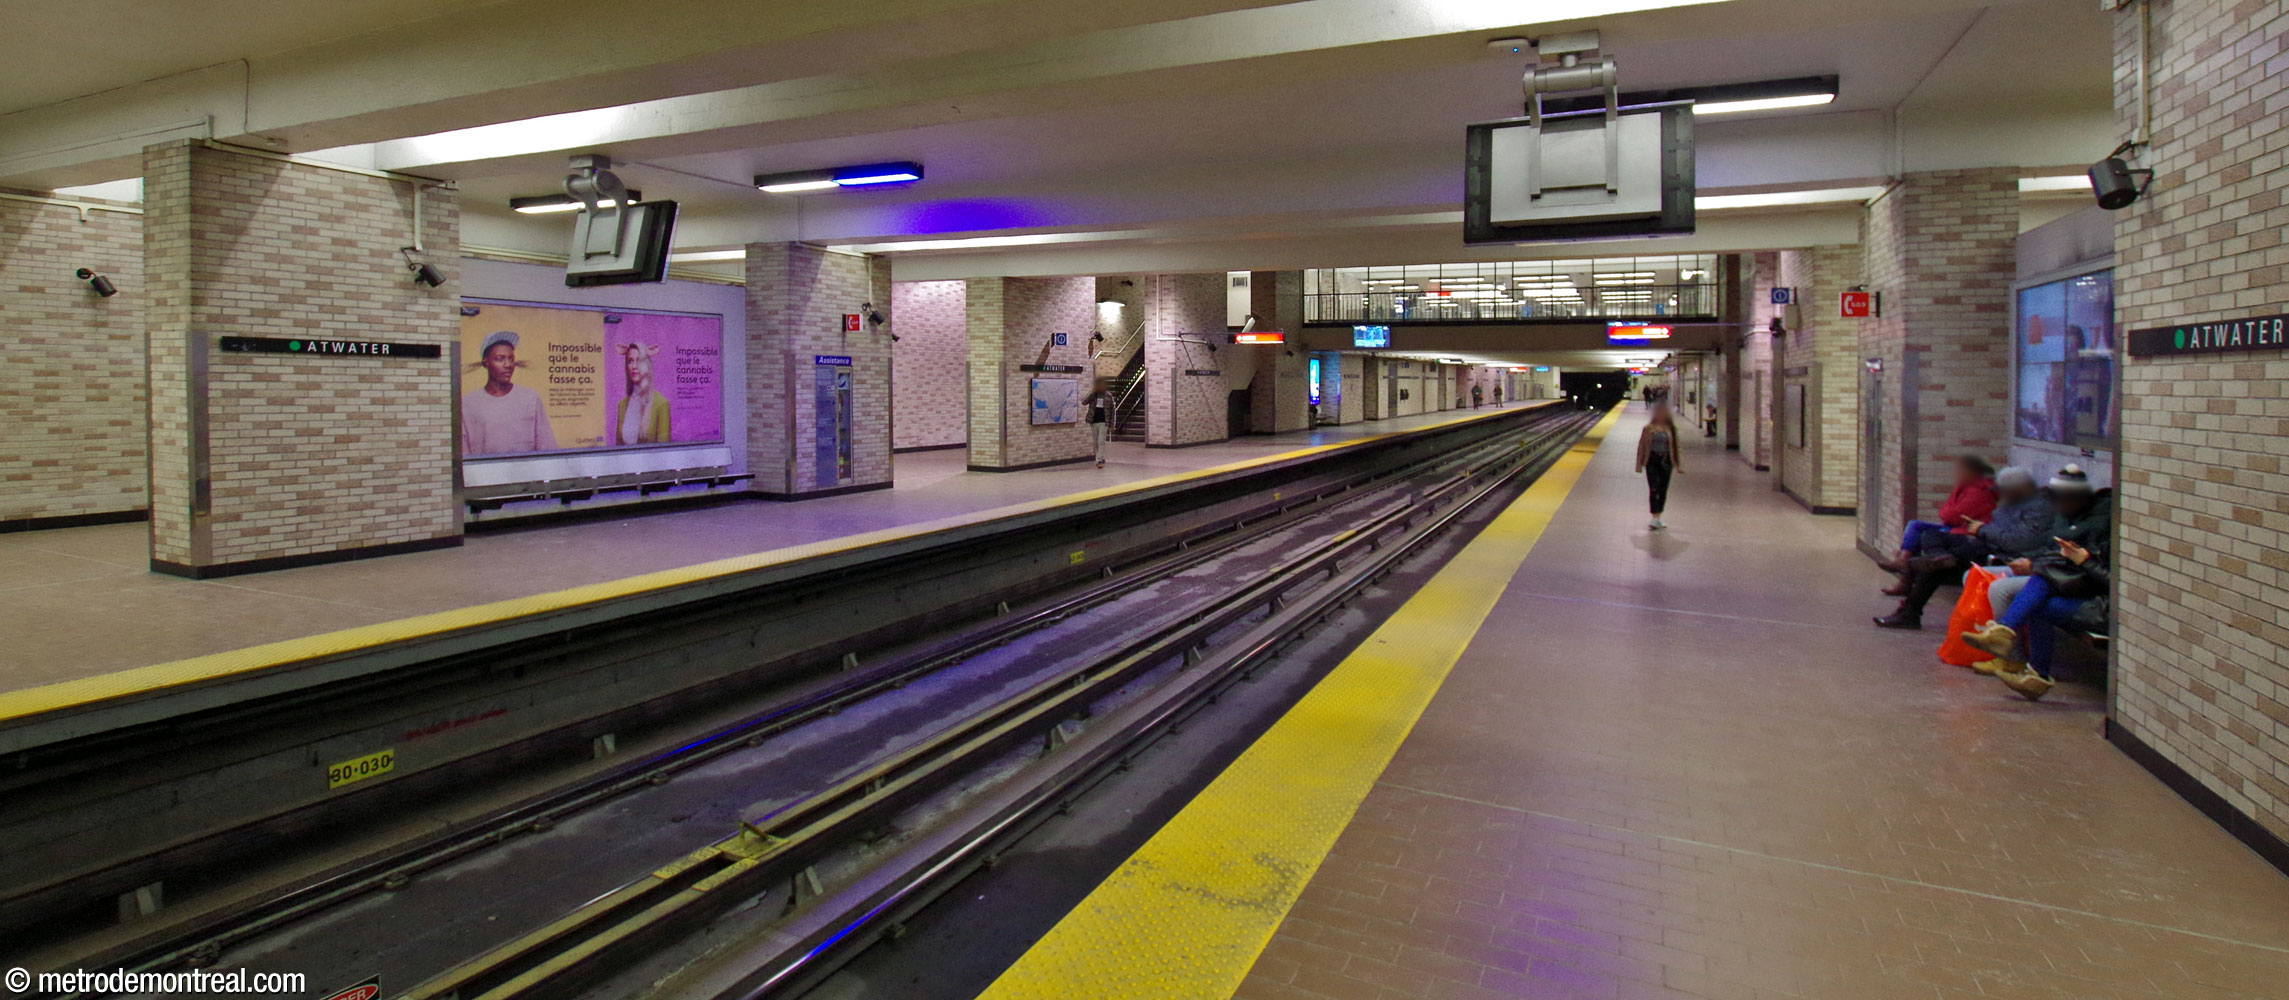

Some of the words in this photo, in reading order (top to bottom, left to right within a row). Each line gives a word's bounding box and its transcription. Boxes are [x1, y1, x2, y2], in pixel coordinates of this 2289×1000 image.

[2190, 318, 2284, 349] ATWATER
[307, 341, 390, 355] ATWATER
[548, 342, 602, 354] Impossible
[675, 346, 719, 357] Impossible
[548, 355, 568, 365] que
[570, 353, 579, 363] le
[675, 357, 691, 366] que
[692, 355, 700, 365] le
[818, 356, 850, 365] Assistance
[548, 363, 595, 373] cannabis
[675, 365, 713, 375] cannabis
[549, 373, 576, 384] fasse
[578, 376, 594, 386] ça.
[676, 374, 698, 384] fasse
